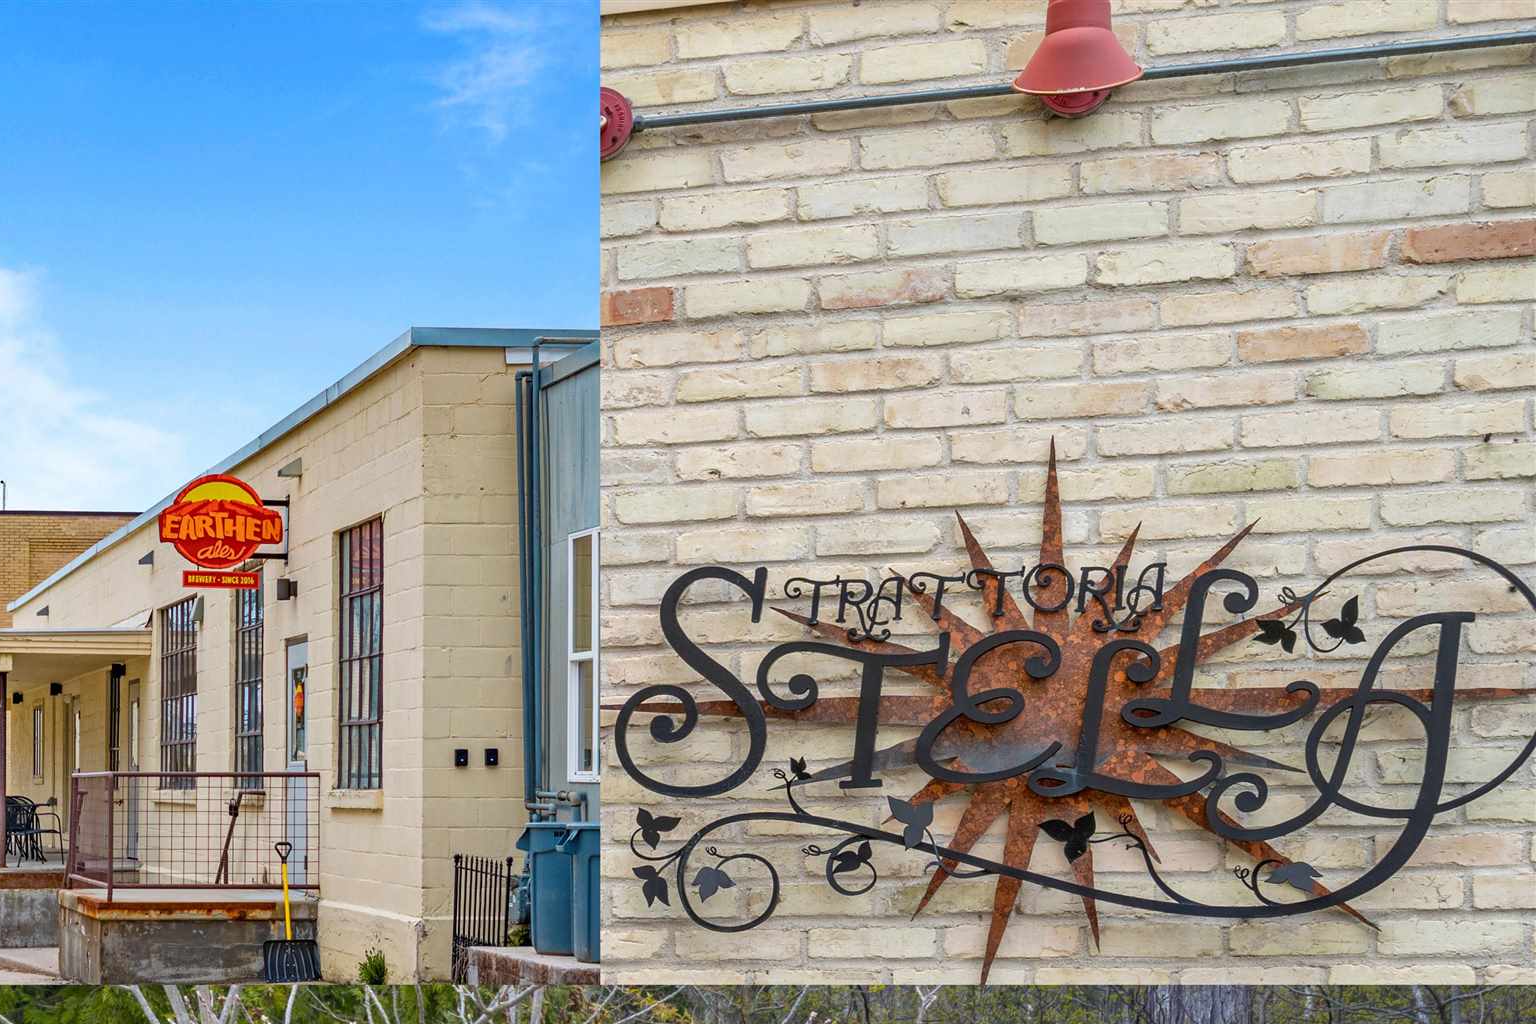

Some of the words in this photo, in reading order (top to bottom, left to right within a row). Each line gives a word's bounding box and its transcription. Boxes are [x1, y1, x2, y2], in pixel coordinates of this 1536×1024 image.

[162, 511, 282, 542] EARTHEN
[197, 540, 246, 560] ales
[188, 575, 216, 584] BREWERY
[221, 576, 239, 584] SINCE
[784, 561, 1168, 643] TRATTORIA
[614, 565, 1476, 840] STELLA
